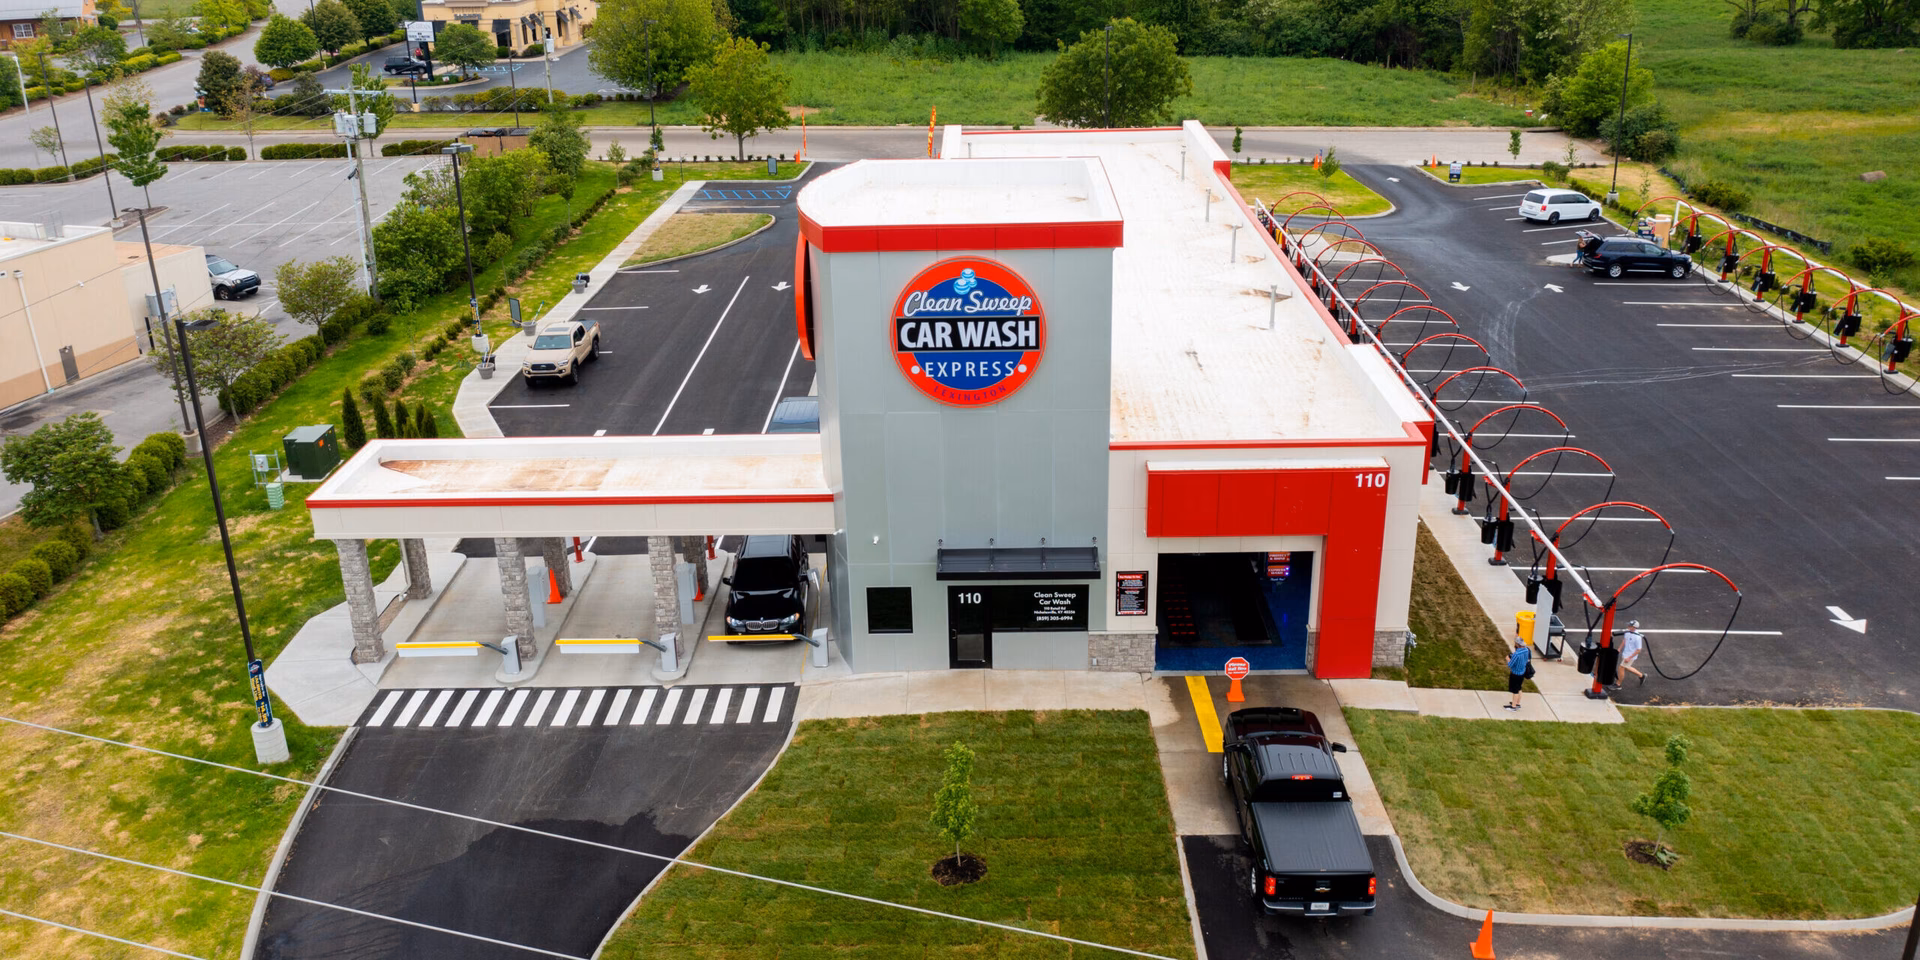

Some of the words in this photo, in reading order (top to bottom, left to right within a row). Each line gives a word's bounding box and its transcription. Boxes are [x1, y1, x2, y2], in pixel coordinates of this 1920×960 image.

[904, 291, 962, 317] Clean
[964, 290, 1032, 316] Sweep
[900, 321, 953, 348] CAR
[957, 320, 1036, 347] WASH
[925, 361, 1014, 377] EXPRESS
[934, 385, 1006, 401] LEXINGTON
[1355, 473, 1386, 488] 110
[957, 592, 982, 604] 110
[1053, 591, 1077, 599] Sweep
